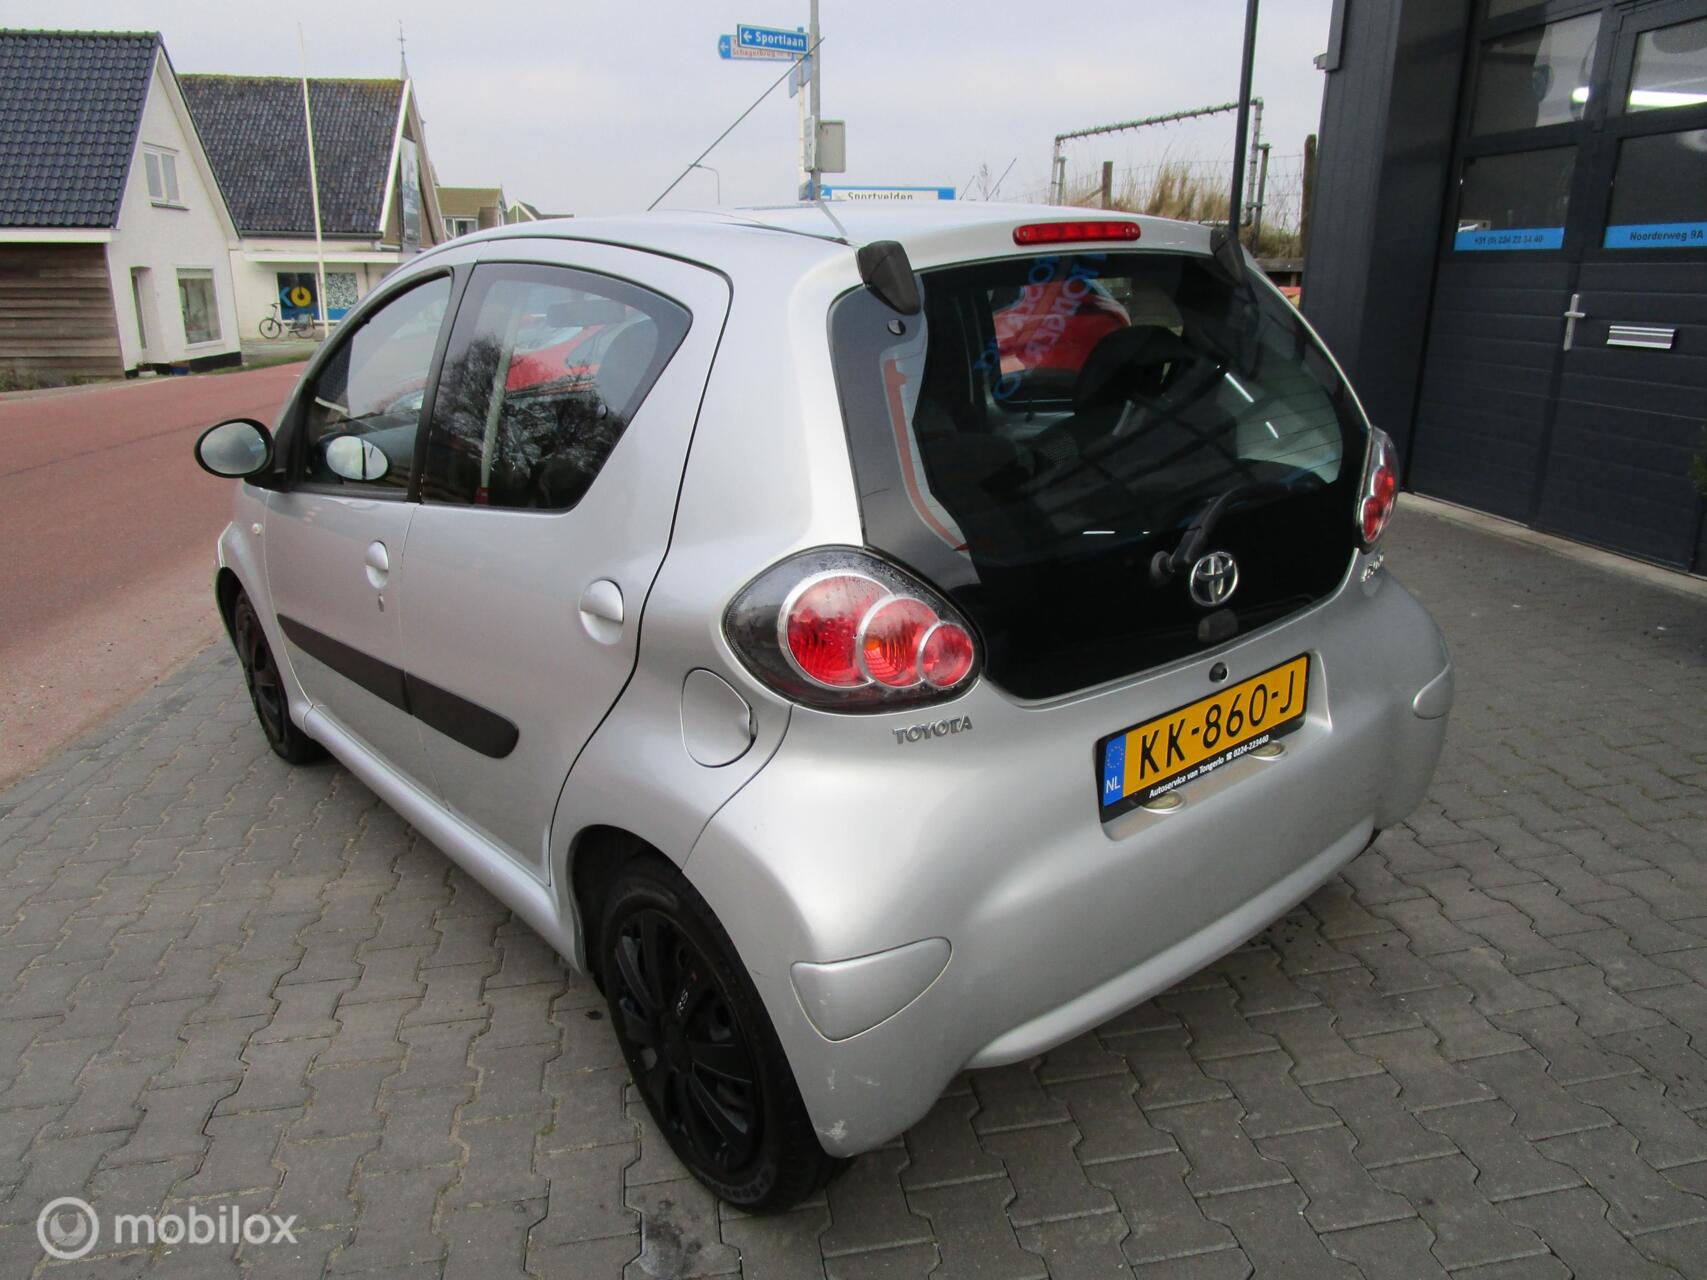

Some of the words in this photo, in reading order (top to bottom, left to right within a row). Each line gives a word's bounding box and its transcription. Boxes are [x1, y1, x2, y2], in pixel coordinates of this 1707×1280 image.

[755, 31, 804, 47] Sportlaan
[1630, 230, 1687, 241] Noorderweg
[1690, 229, 1704, 240] 9A
[892, 715, 974, 745] TOYOTA
[1139, 670, 1296, 780] KK-860-J
[1105, 775, 1121, 794] NL
[1149, 774, 1186, 798] Autoservice
